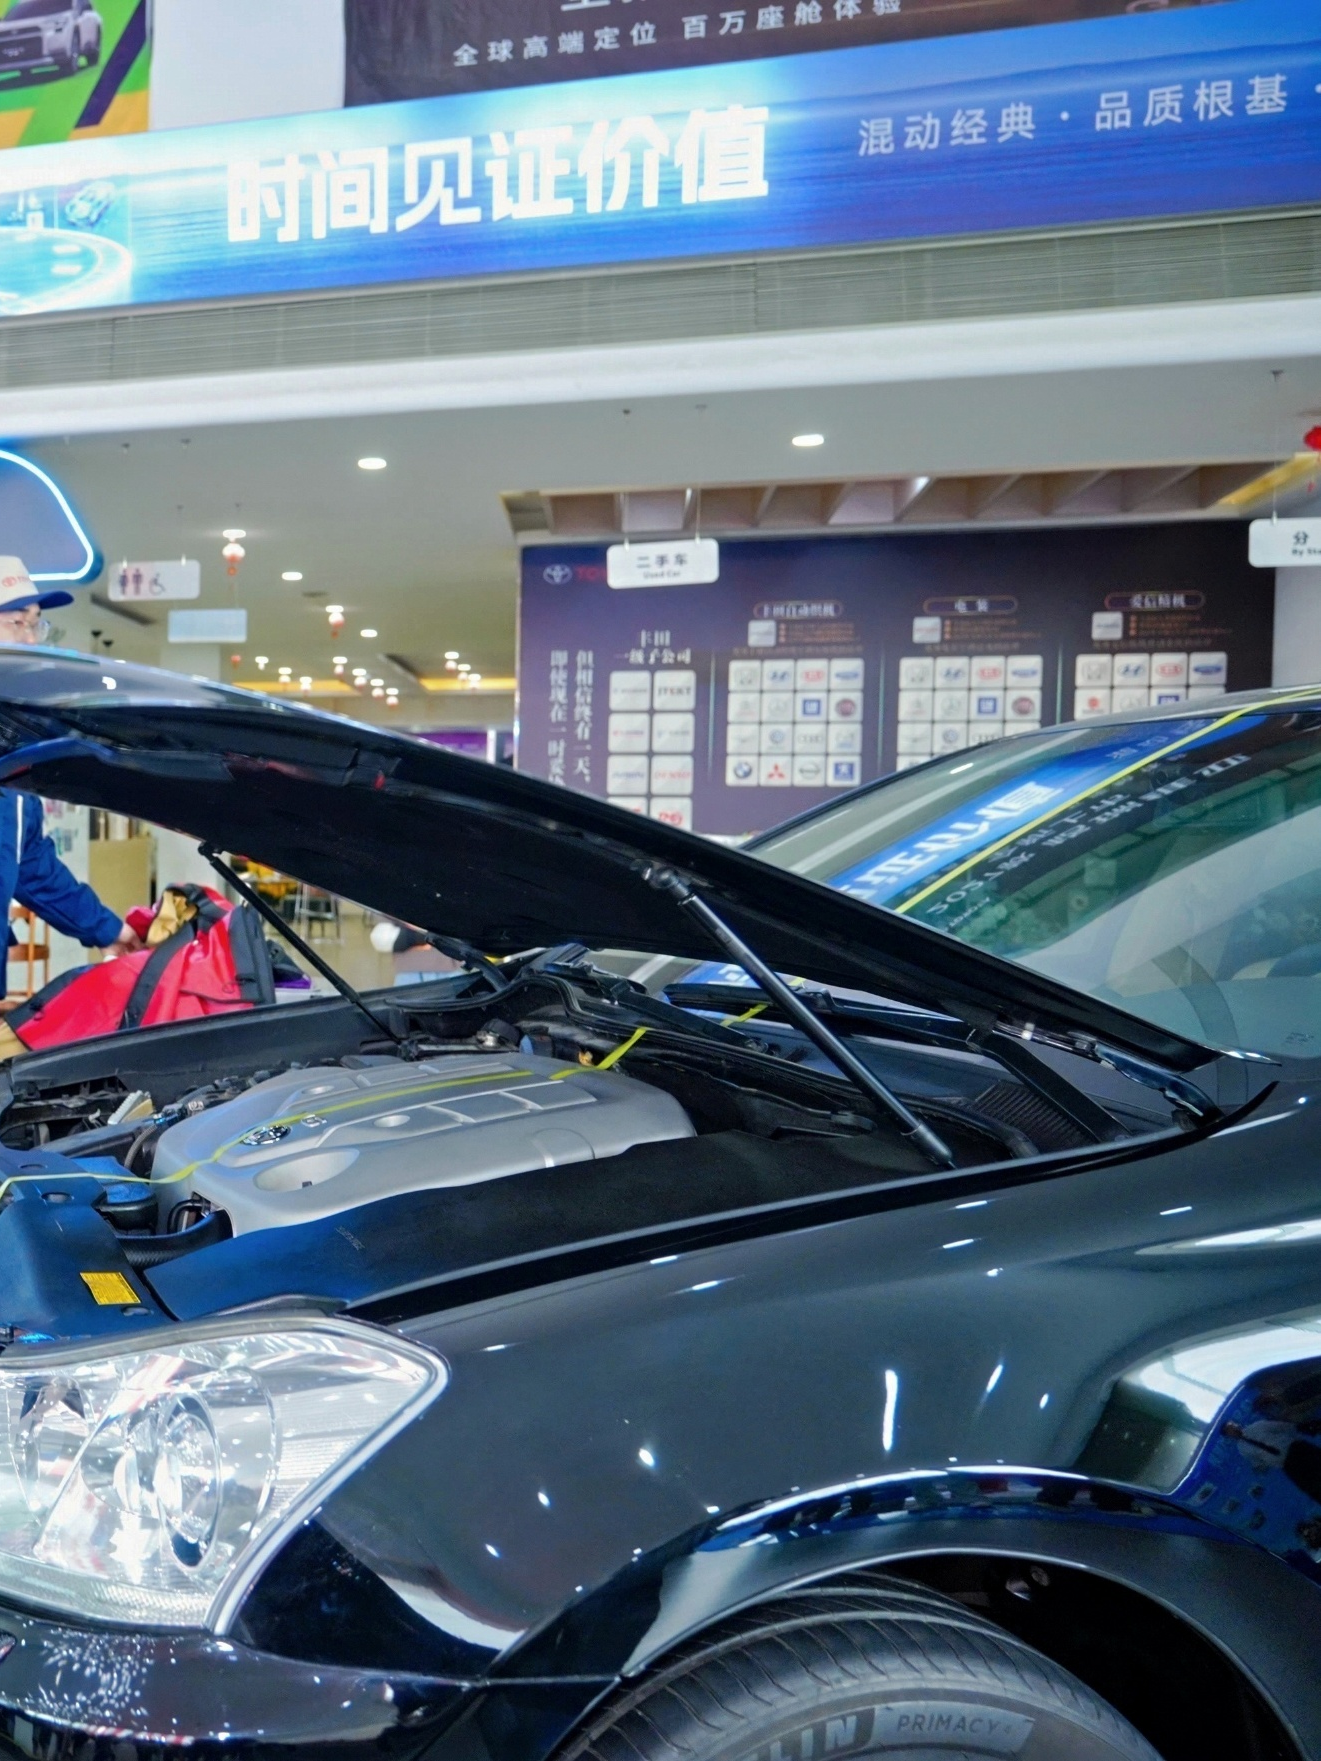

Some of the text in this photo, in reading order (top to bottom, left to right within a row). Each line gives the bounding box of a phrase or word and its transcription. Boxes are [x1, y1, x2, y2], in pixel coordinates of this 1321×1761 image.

[453, 0, 901, 67] 全球高端定位 百万座舱体验
[227, 104, 770, 243] 时间见证价值
[636, 553, 688, 568] 二手车
[897, 1712, 1000, 1735] PRIMACY
